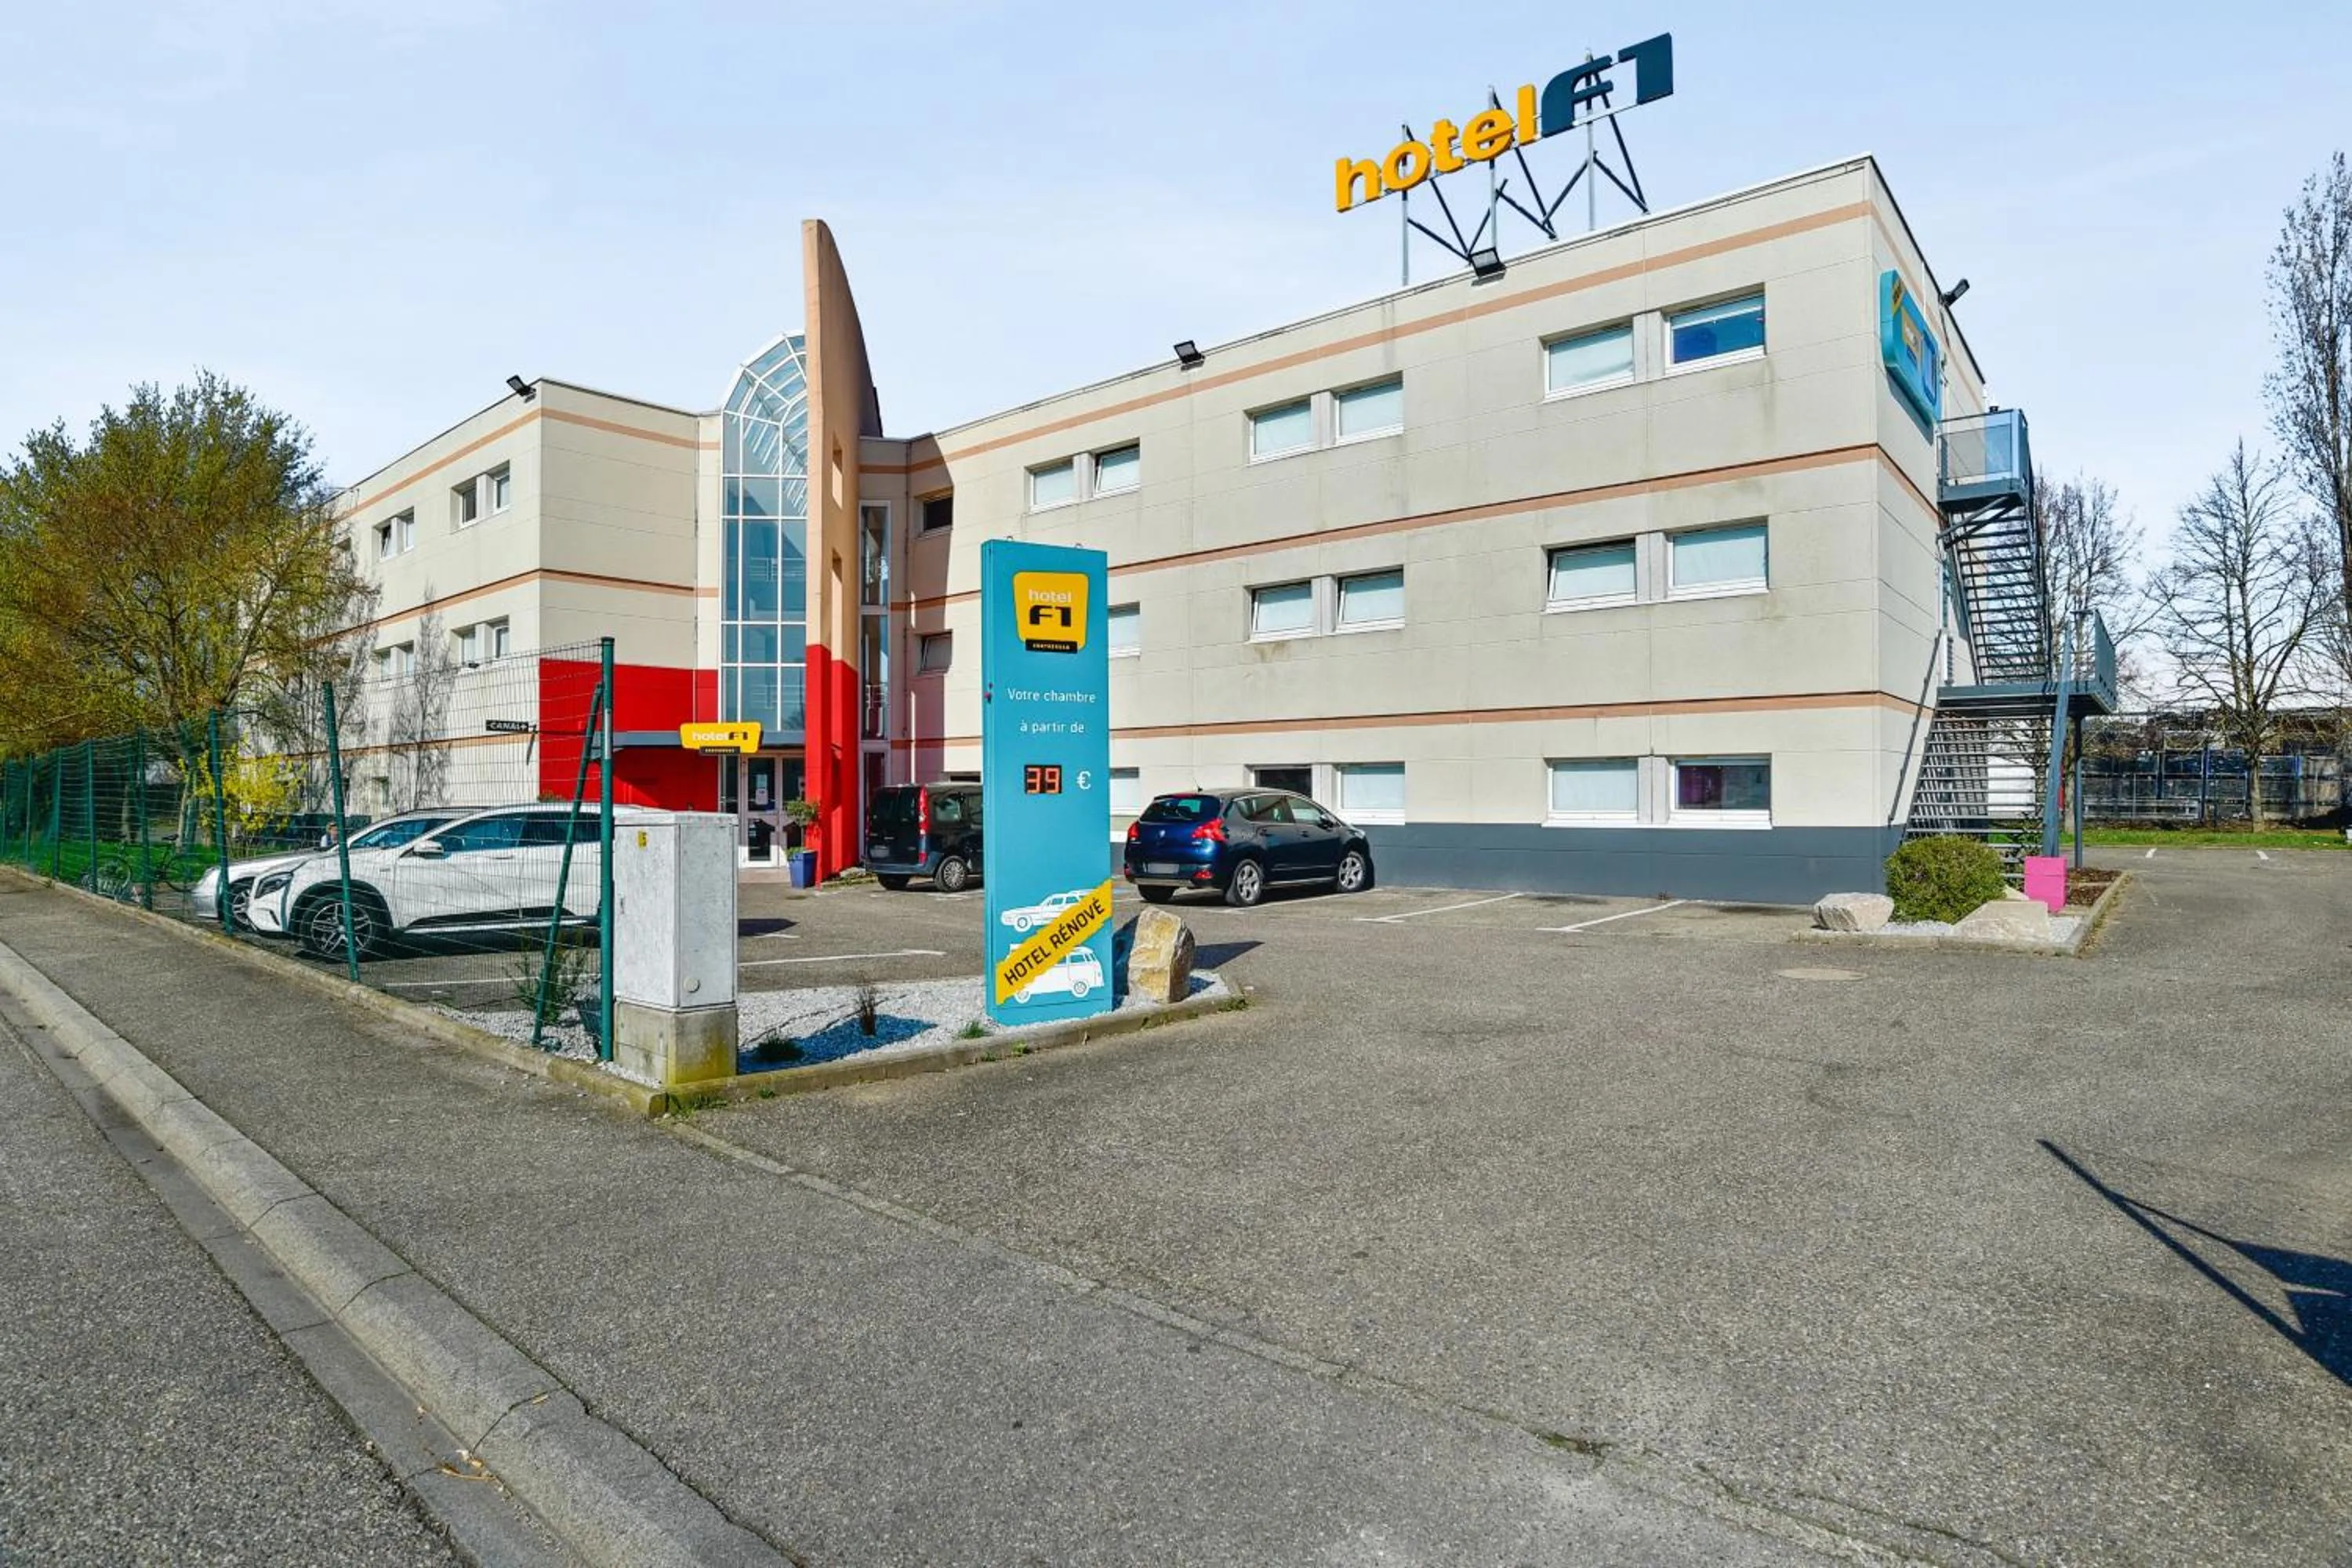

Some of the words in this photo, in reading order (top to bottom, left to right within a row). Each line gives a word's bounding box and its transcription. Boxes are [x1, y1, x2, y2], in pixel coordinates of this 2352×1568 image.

[1029, 589, 1072, 603] hotel
[1029, 604, 1072, 627] F1
[1007, 688, 1040, 702] Votre
[1044, 690, 1095, 703] chambre
[1020, 720, 1028, 732] à
[1032, 722, 1065, 734] partir
[1070, 721, 1084, 733] de
[1027, 768, 1060, 793] 39
[1076, 771, 1091, 789] €
[1004, 946, 1051, 985] HOTEL
[1049, 898, 1105, 949] RÉNOVÉ
